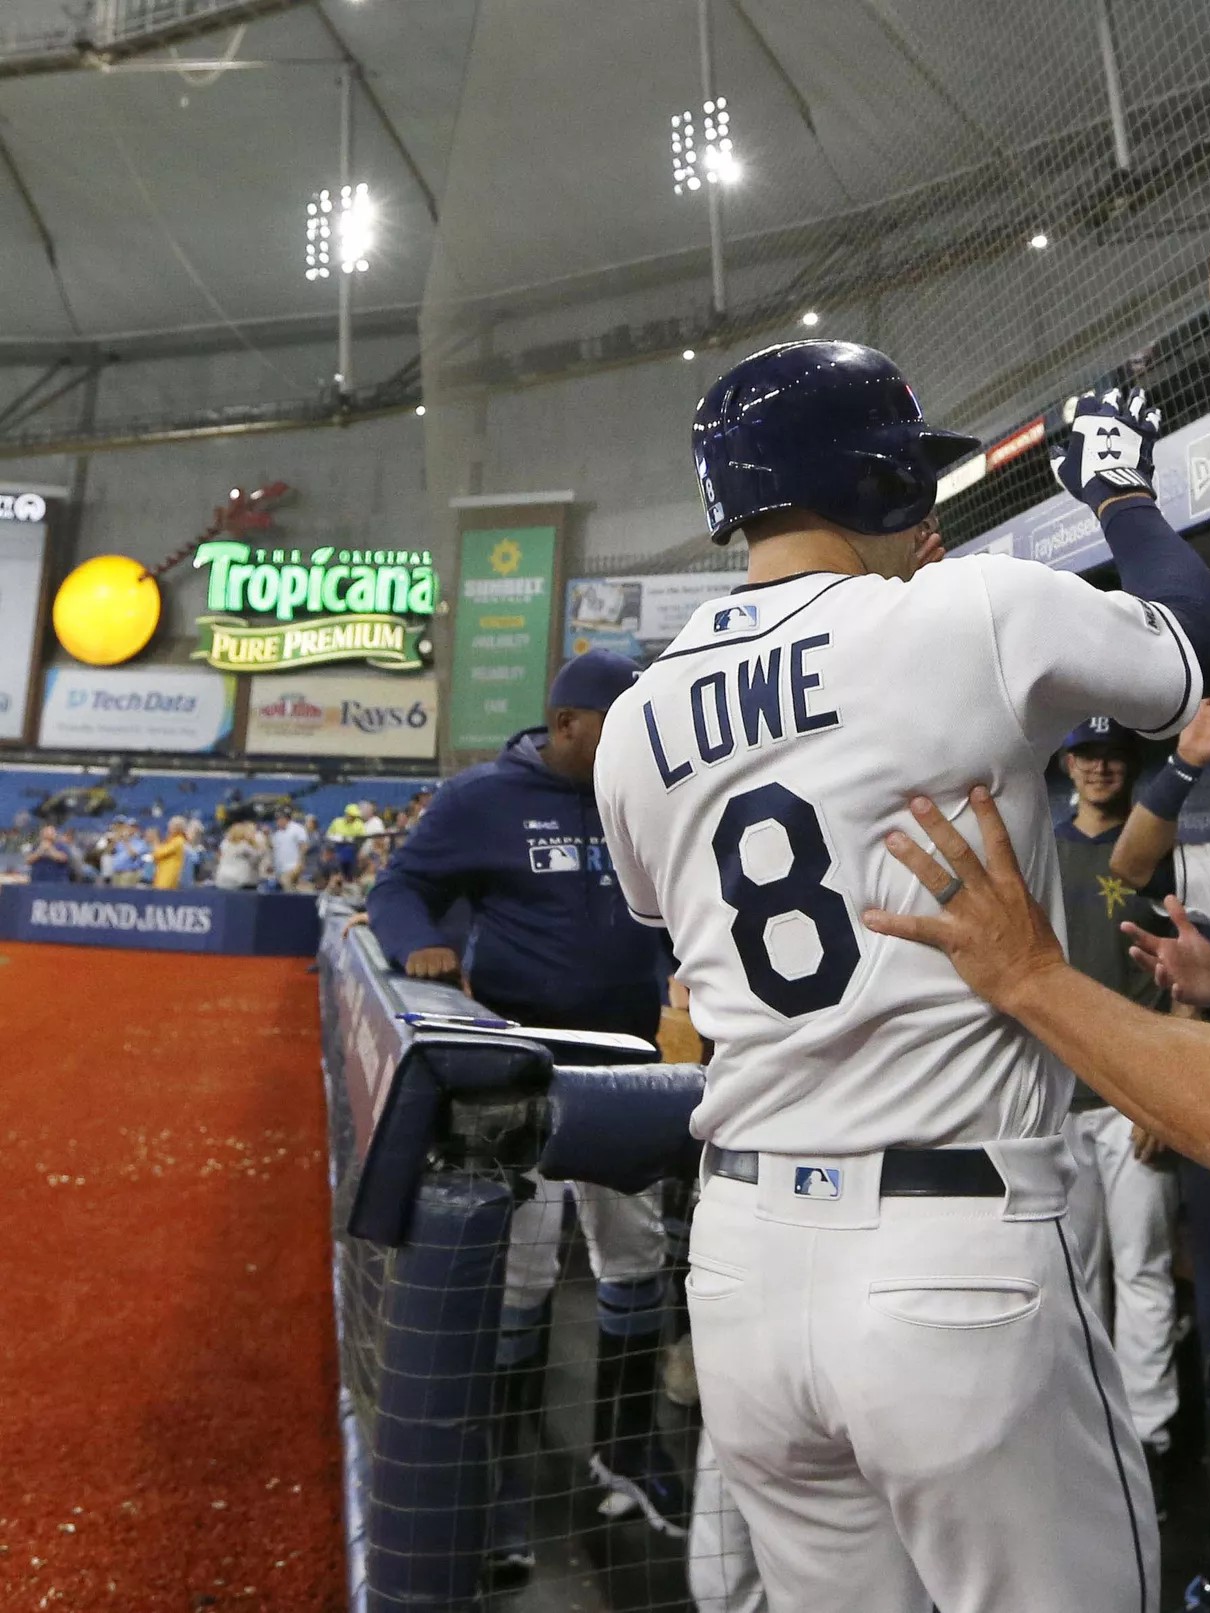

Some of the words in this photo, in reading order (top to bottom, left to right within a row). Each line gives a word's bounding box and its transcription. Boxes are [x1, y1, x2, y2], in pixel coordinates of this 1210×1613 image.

[706, 478, 715, 502] 8
[255, 549, 301, 563] THE
[339, 550, 433, 565] ORIGINAL
[193, 541, 436, 620] Tropicana
[212, 632, 279, 663] PURE
[283, 623, 404, 659] PREMIUM
[642, 632, 842, 793] LOWE
[527, 836, 583, 846] TAMPA
[31, 899, 137, 930] RAYMOND
[137, 904, 212, 934] JAMES
[712, 781, 863, 1019] 8
